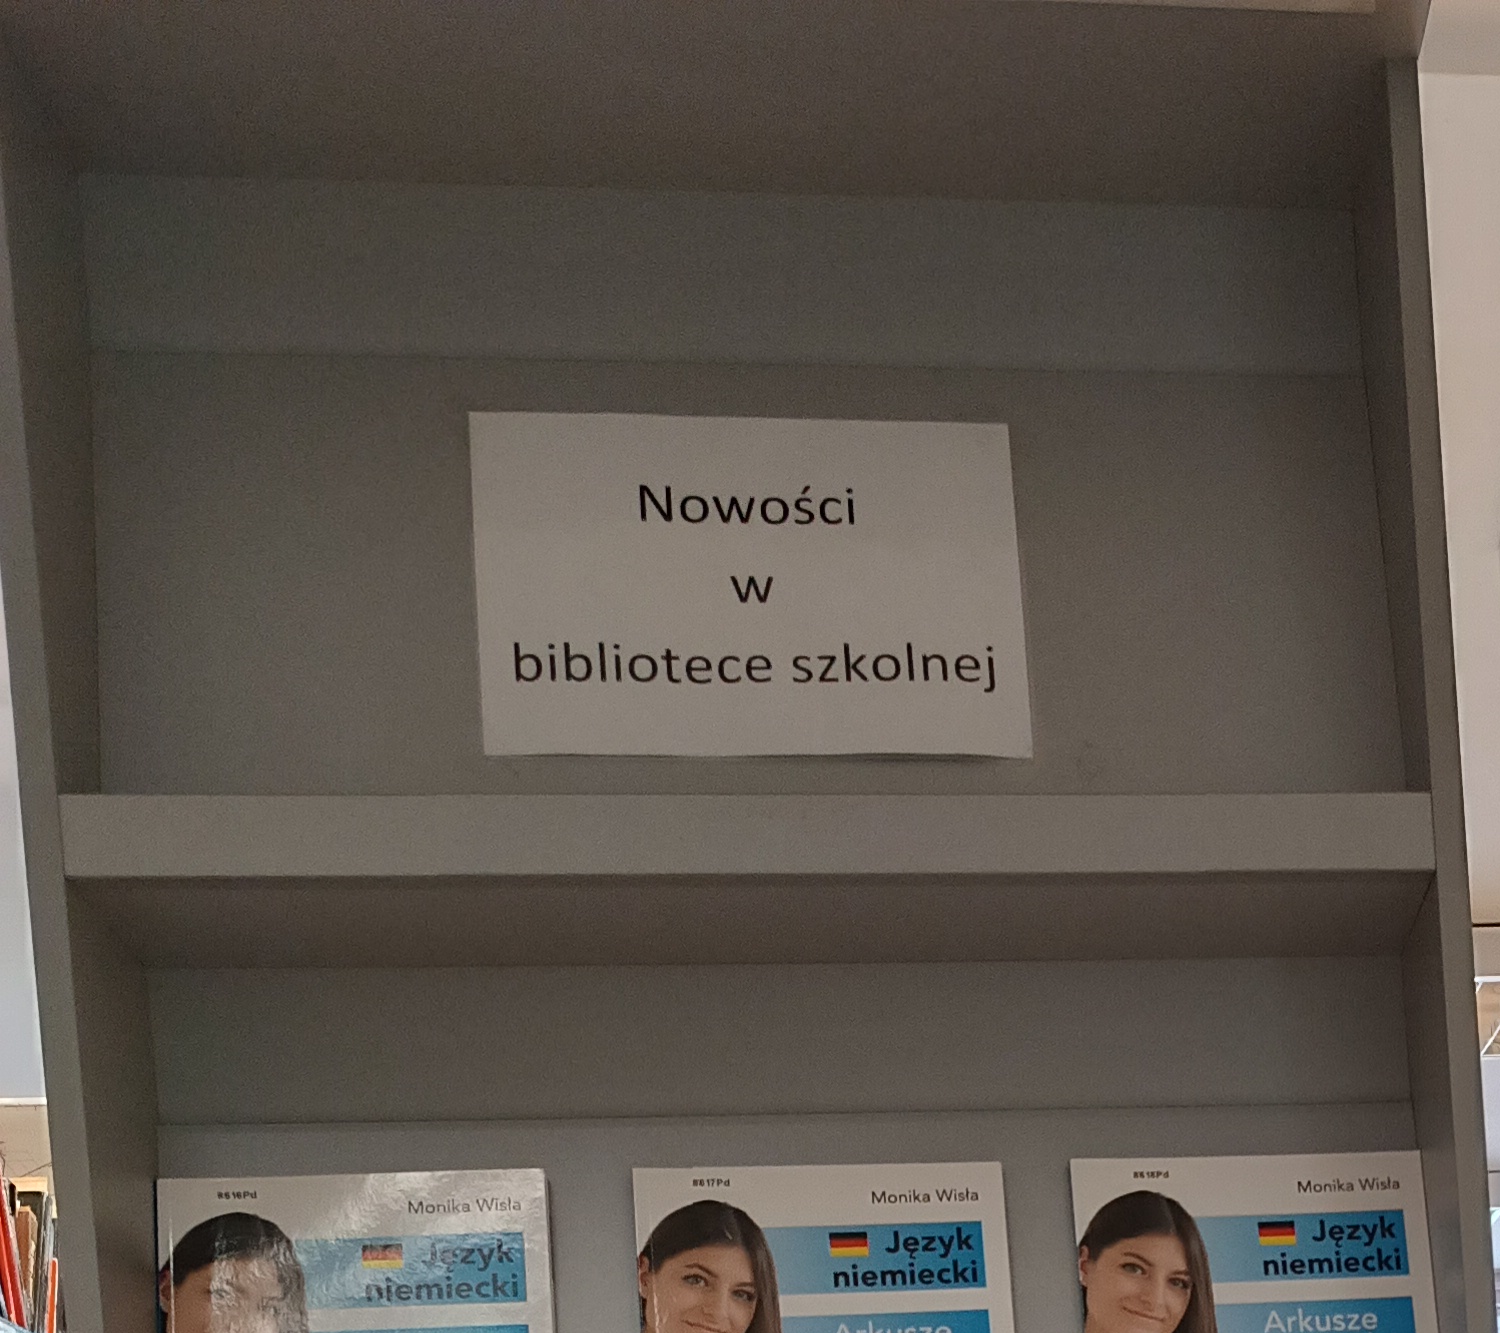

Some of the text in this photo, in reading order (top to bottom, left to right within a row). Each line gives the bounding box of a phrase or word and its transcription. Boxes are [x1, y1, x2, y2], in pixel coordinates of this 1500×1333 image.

[639, 484, 855, 525] Nowości
[731, 576, 773, 604] w
[513, 642, 997, 693] bibliotece szkolnej
[871, 1188, 979, 1204] Monika Wisła
[1297, 1176, 1400, 1196] Monika Wisła
[885, 1228, 973, 1258] Język
[1312, 1217, 1397, 1247] Język
[420, 1239, 515, 1270] Język
[1262, 1247, 1402, 1278] niemiecki
[364, 1272, 519, 1303] niemiecki
[833, 1260, 978, 1288] niemiecki
